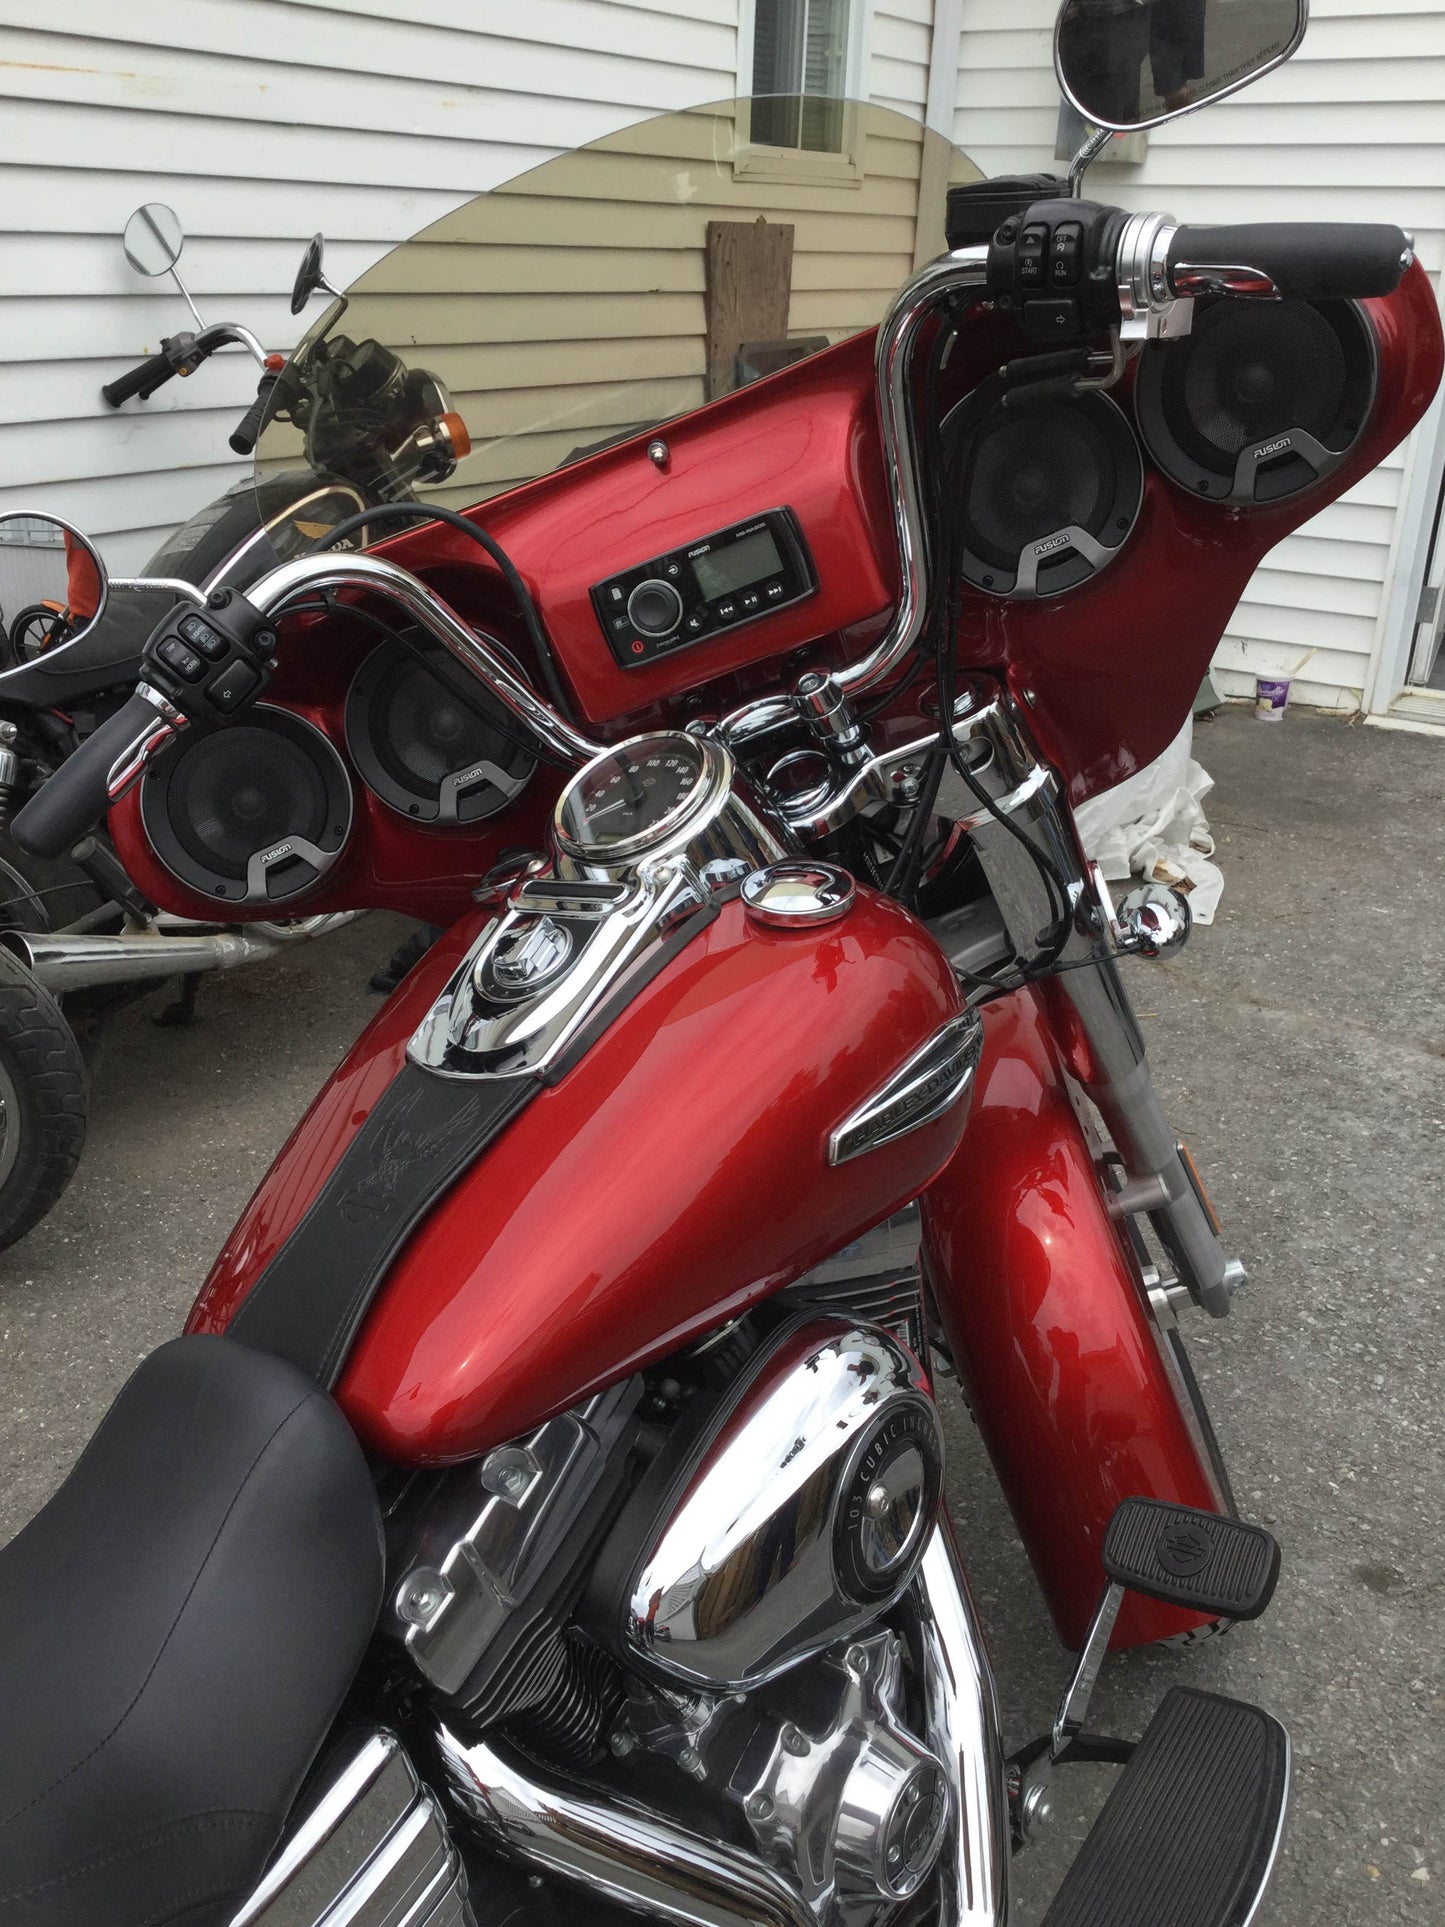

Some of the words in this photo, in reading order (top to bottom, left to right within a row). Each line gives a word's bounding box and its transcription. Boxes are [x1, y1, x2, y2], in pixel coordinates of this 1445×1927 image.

[1056, 235, 1067, 243] OFF
[1253, 437, 1292, 459] FUSION
[688, 544, 711, 558] FUSION
[1034, 533, 1070, 554] FUSION
[452, 767, 483, 786] FUSION
[676, 766, 689, 774] 140
[610, 776, 621, 784] 60
[586, 804, 596, 812] 20
[260, 843, 291, 863] FUSION
[848, 1495, 863, 1530] 103
[860, 1423, 897, 1482] CUBIC
